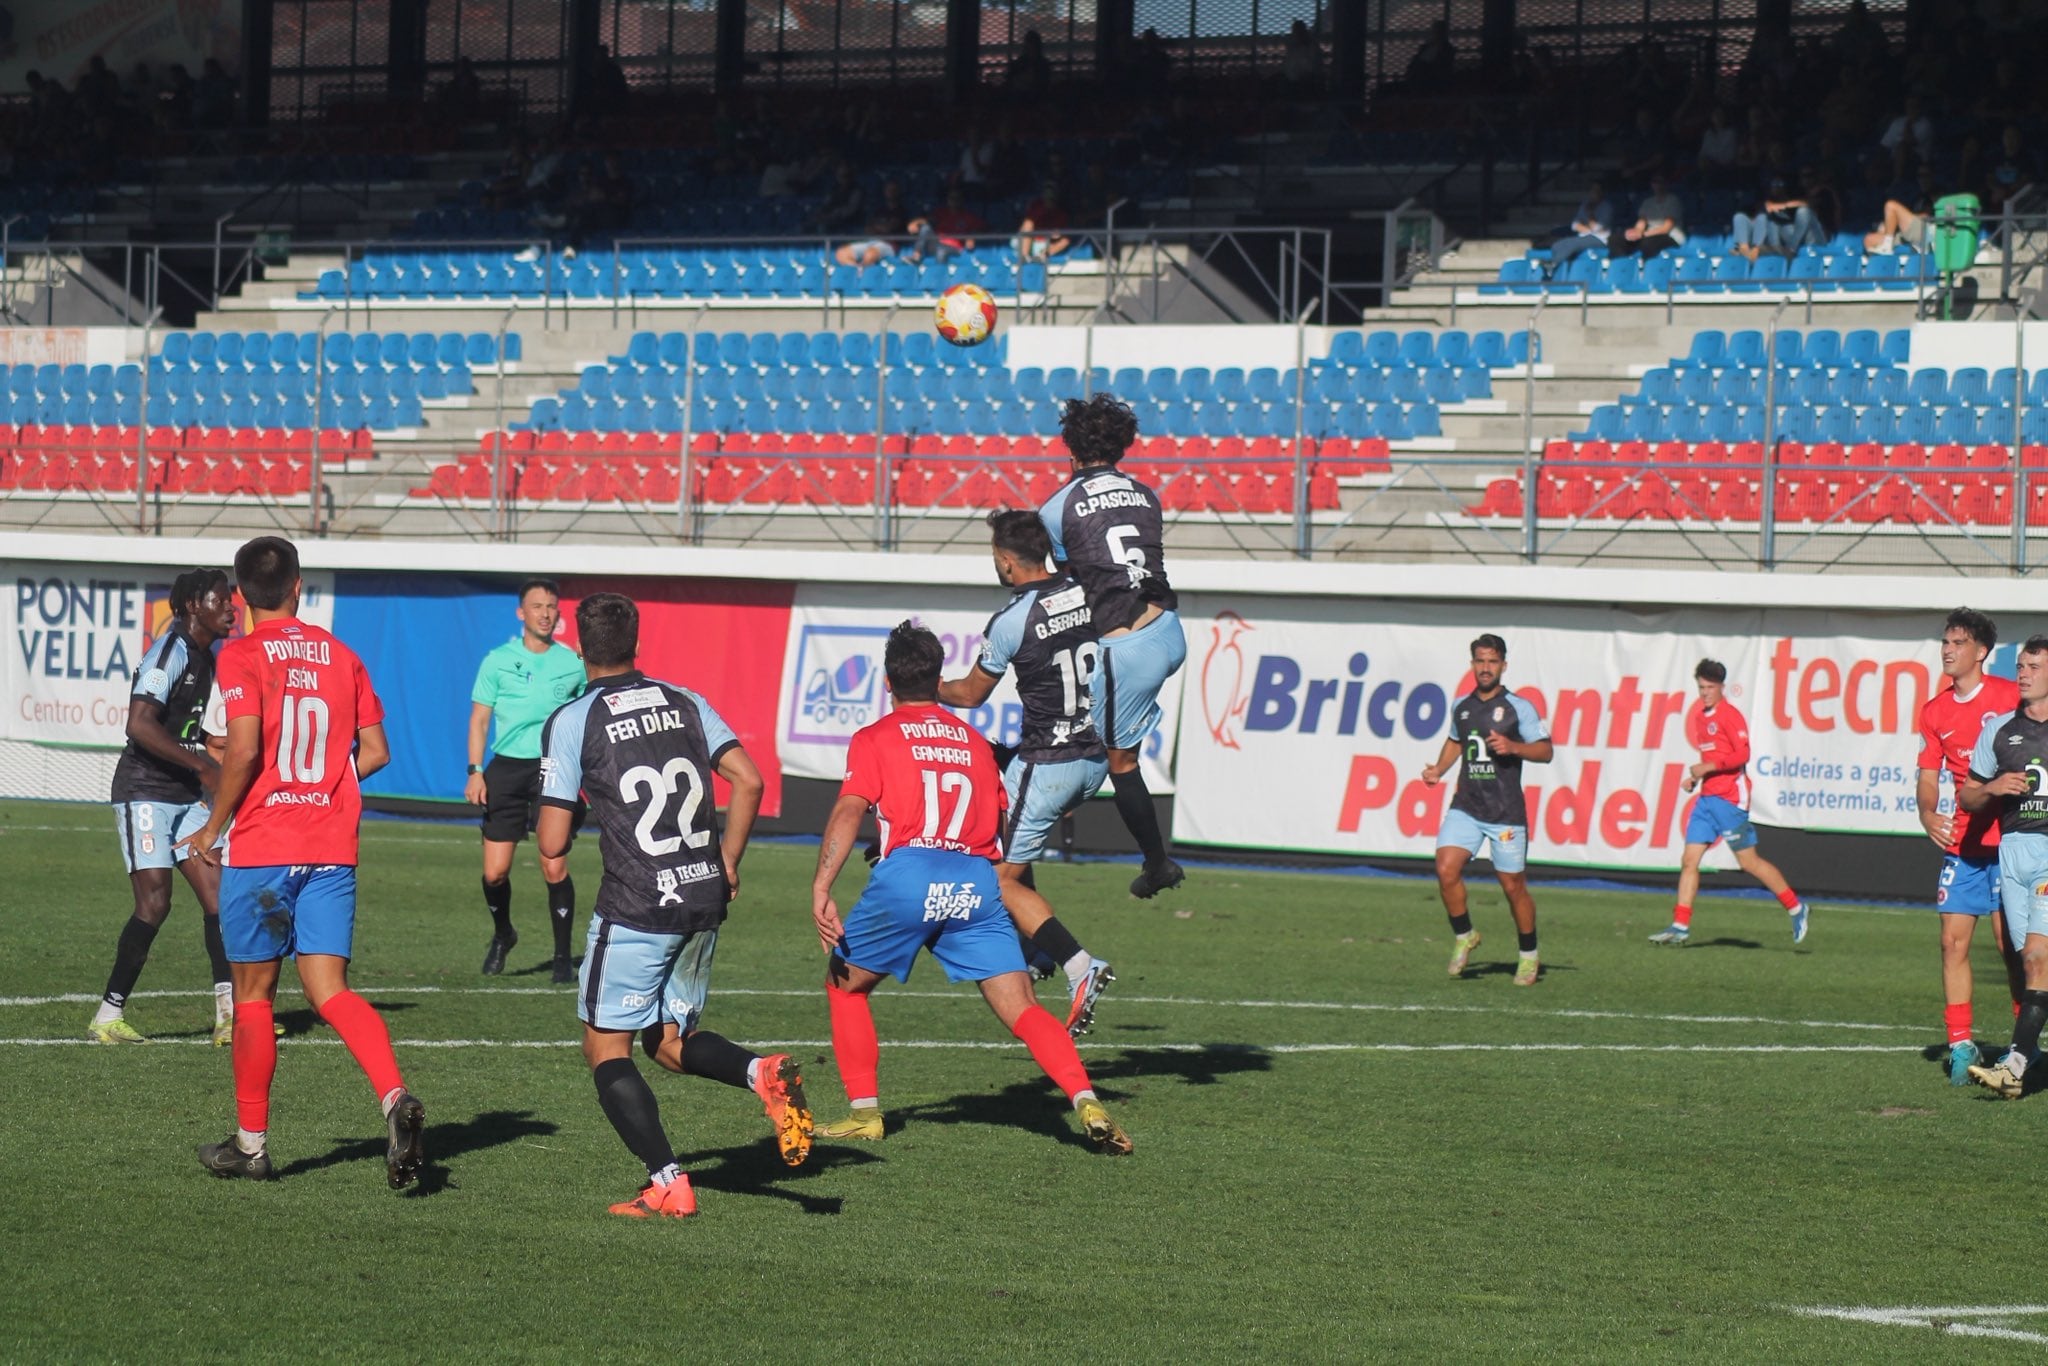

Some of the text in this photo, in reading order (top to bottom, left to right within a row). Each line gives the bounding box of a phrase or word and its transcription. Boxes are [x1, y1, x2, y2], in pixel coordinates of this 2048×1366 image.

[1075, 492, 1151, 517] C.PASCUAL
[17, 577, 137, 629] PONTE
[18, 629, 131, 682] VELLA
[263, 640, 331, 666] POVARELO
[1770, 636, 1953, 735] tecn
[20, 694, 83, 724] Centro
[277, 695, 330, 784] 10
[605, 706, 685, 744] FER DÍAZ
[900, 723, 969, 744] POVARELO
[912, 746, 971, 767] GAMARRA
[1756, 755, 1843, 781] Caldeiras
[1850, 765, 1861, 781] a
[1868, 766, 1907, 787] gas,
[270, 792, 330, 808] ABANCA
[620, 757, 710, 857] 22
[922, 769, 973, 840] 17
[1777, 789, 1887, 813] aerotermia,
[138, 803, 153, 832] 8
[924, 893, 982, 910] CRUSH
[928, 882, 955, 897] MY
